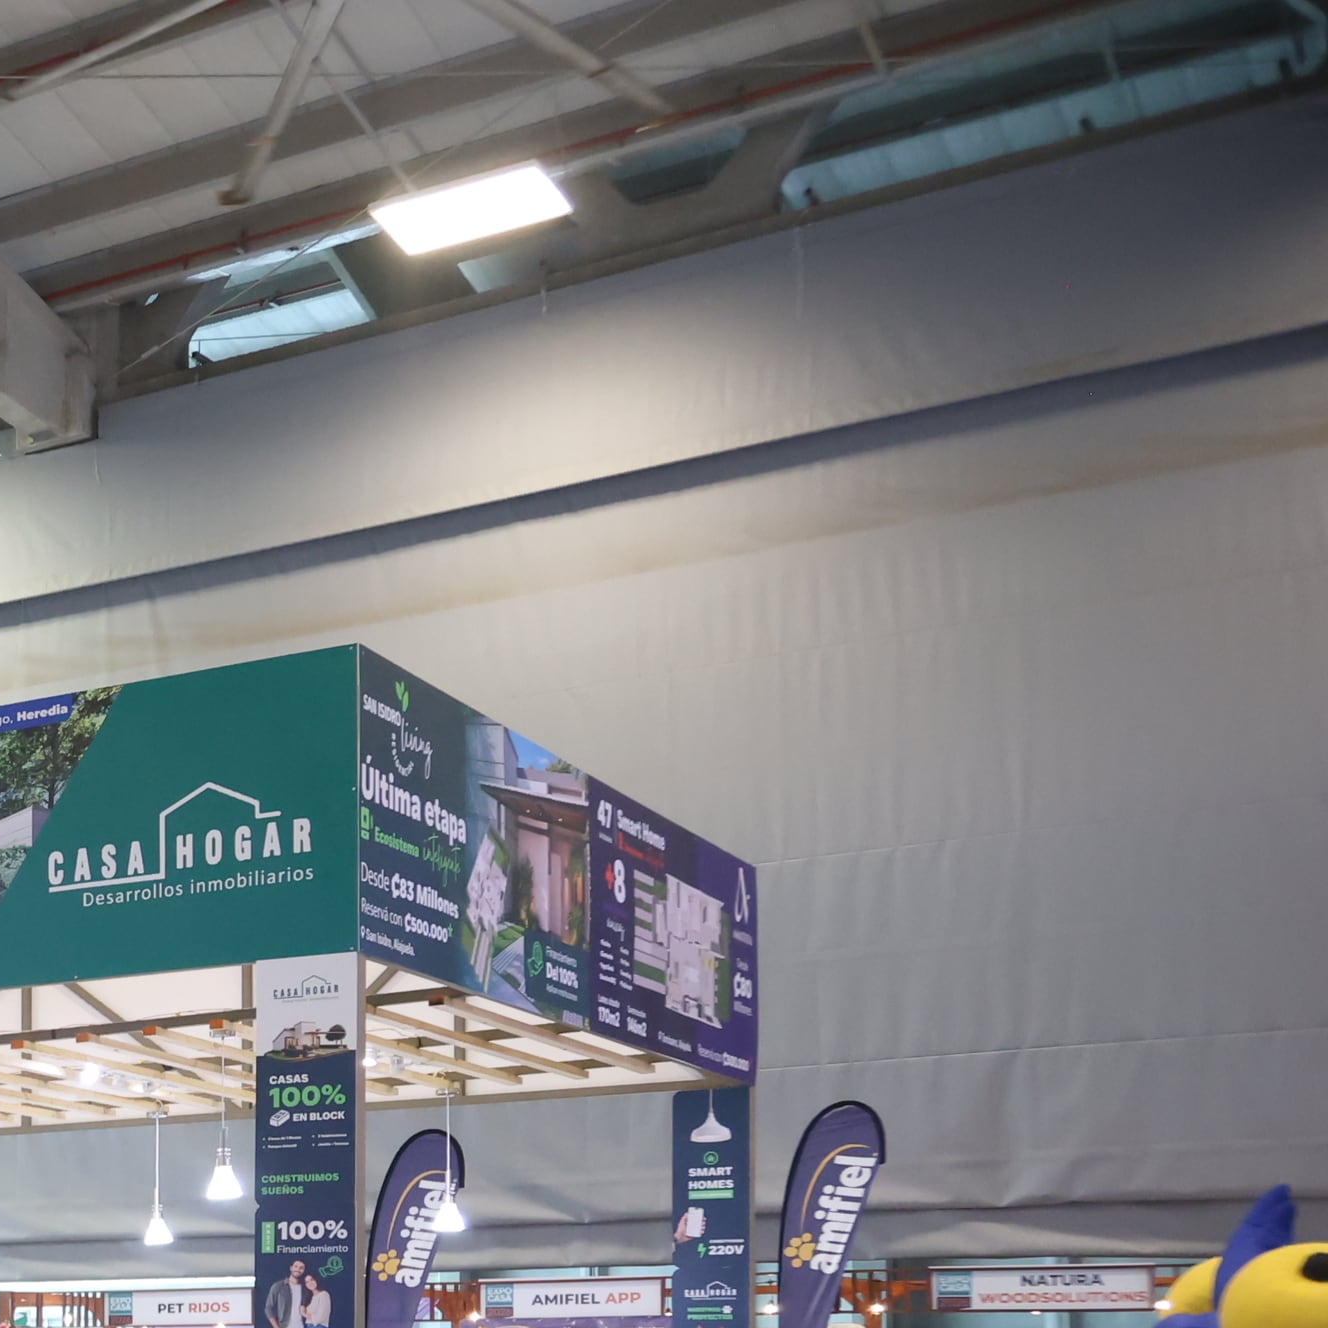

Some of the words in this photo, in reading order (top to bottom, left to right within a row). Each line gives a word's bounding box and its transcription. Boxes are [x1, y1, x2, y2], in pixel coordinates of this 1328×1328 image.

[16, 704, 69, 722] Heredia
[361, 754, 422, 822] Última
[424, 798, 468, 847] etapa
[374, 825, 420, 858] Ecosistema
[47, 840, 145, 886] CASA
[175, 817, 313, 870] HOGAR
[82, 882, 184, 907] Desarrollos
[189, 866, 315, 895] inmobiliarios
[360, 861, 391, 893] Desde
[415, 883, 461, 920] Millones
[273, 988, 299, 999] CASA
[305, 984, 339, 996] HOGAR
[269, 1073, 309, 1085] CASAS
[269, 1084, 346, 1108] 100%
[292, 1112, 308, 1122] EN
[309, 1110, 346, 1122] BLOCK
[261, 1172, 340, 1184] CONSTRUIMOS
[688, 1166, 734, 1178] SMART
[261, 1184, 305, 1196] SUEÑOS
[688, 1179, 735, 1190] HOMES
[809, 1153, 879, 1275] amifiel
[277, 1219, 349, 1240] 100%
[276, 1244, 350, 1254] Financiamiento
[707, 1244, 745, 1256] 220V
[1019, 1273, 1105, 1287] NATURA
[531, 1293, 601, 1306] AMIFIEL
[604, 1292, 641, 1304] APP
[978, 1291, 1151, 1304] WOODSOLUTIONS
[157, 1302, 184, 1315] PET
[187, 1301, 231, 1315] RIJOS
